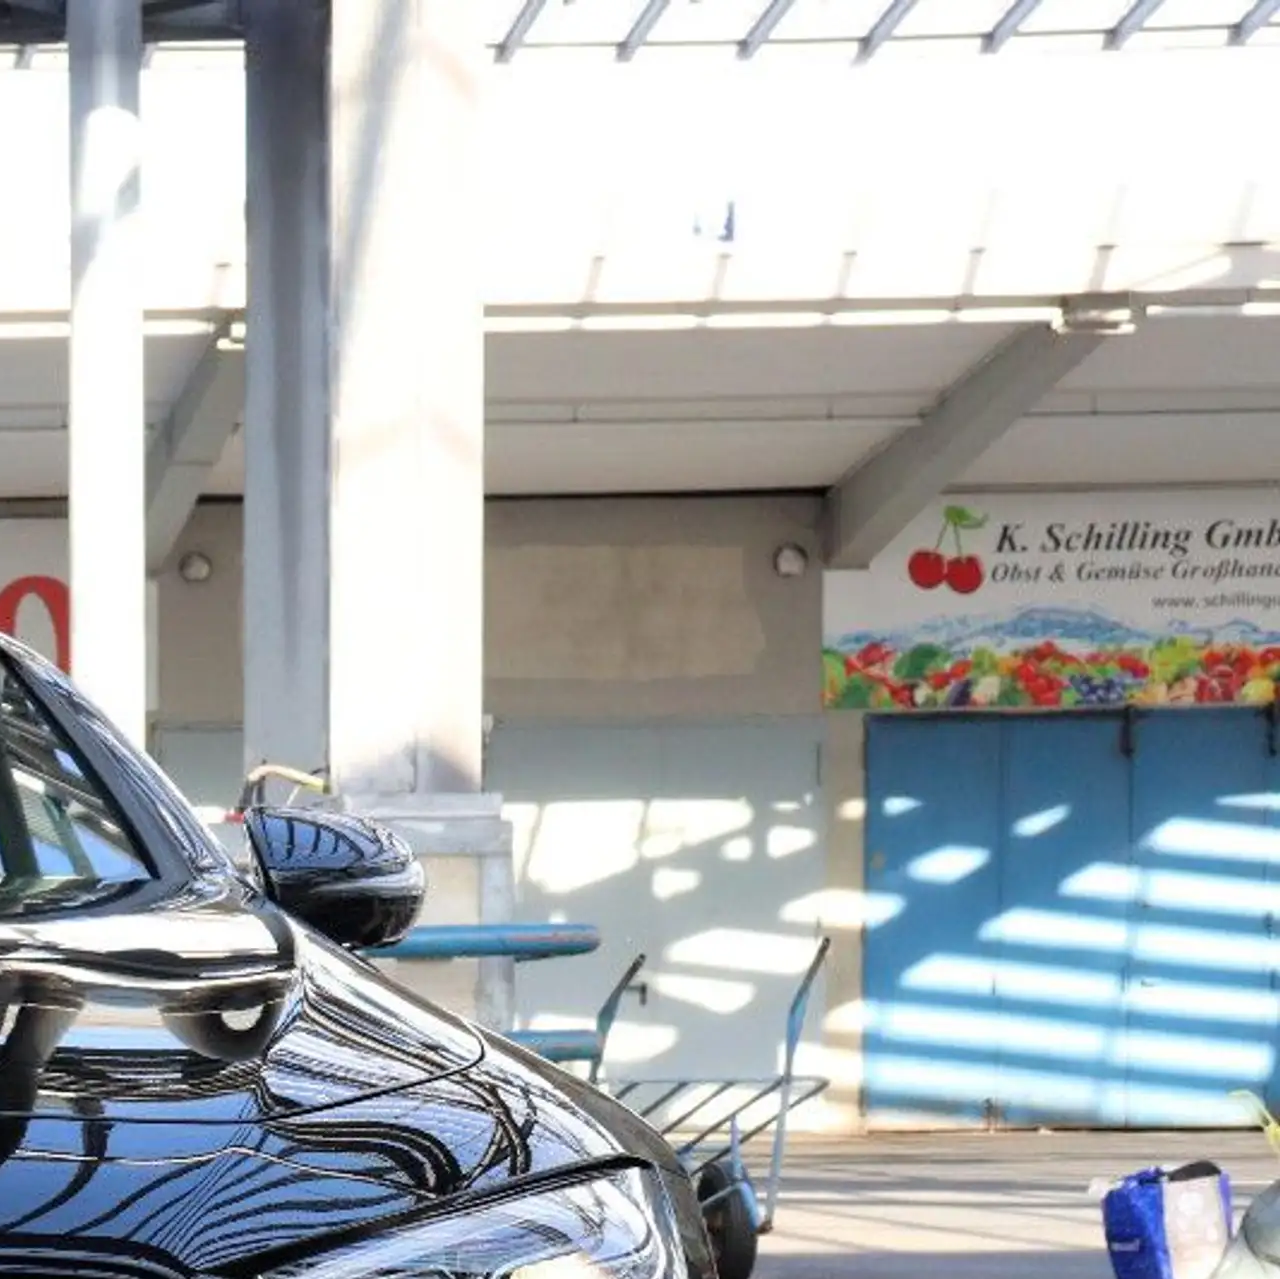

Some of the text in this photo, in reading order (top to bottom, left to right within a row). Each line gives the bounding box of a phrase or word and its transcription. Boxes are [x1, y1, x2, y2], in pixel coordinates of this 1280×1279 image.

[996, 522, 1028, 552] K.
[1041, 521, 1191, 557] Schilling
[991, 562, 1040, 583] Obst
[1047, 563, 1065, 583] &
[1076, 561, 1165, 583] Gemüse
